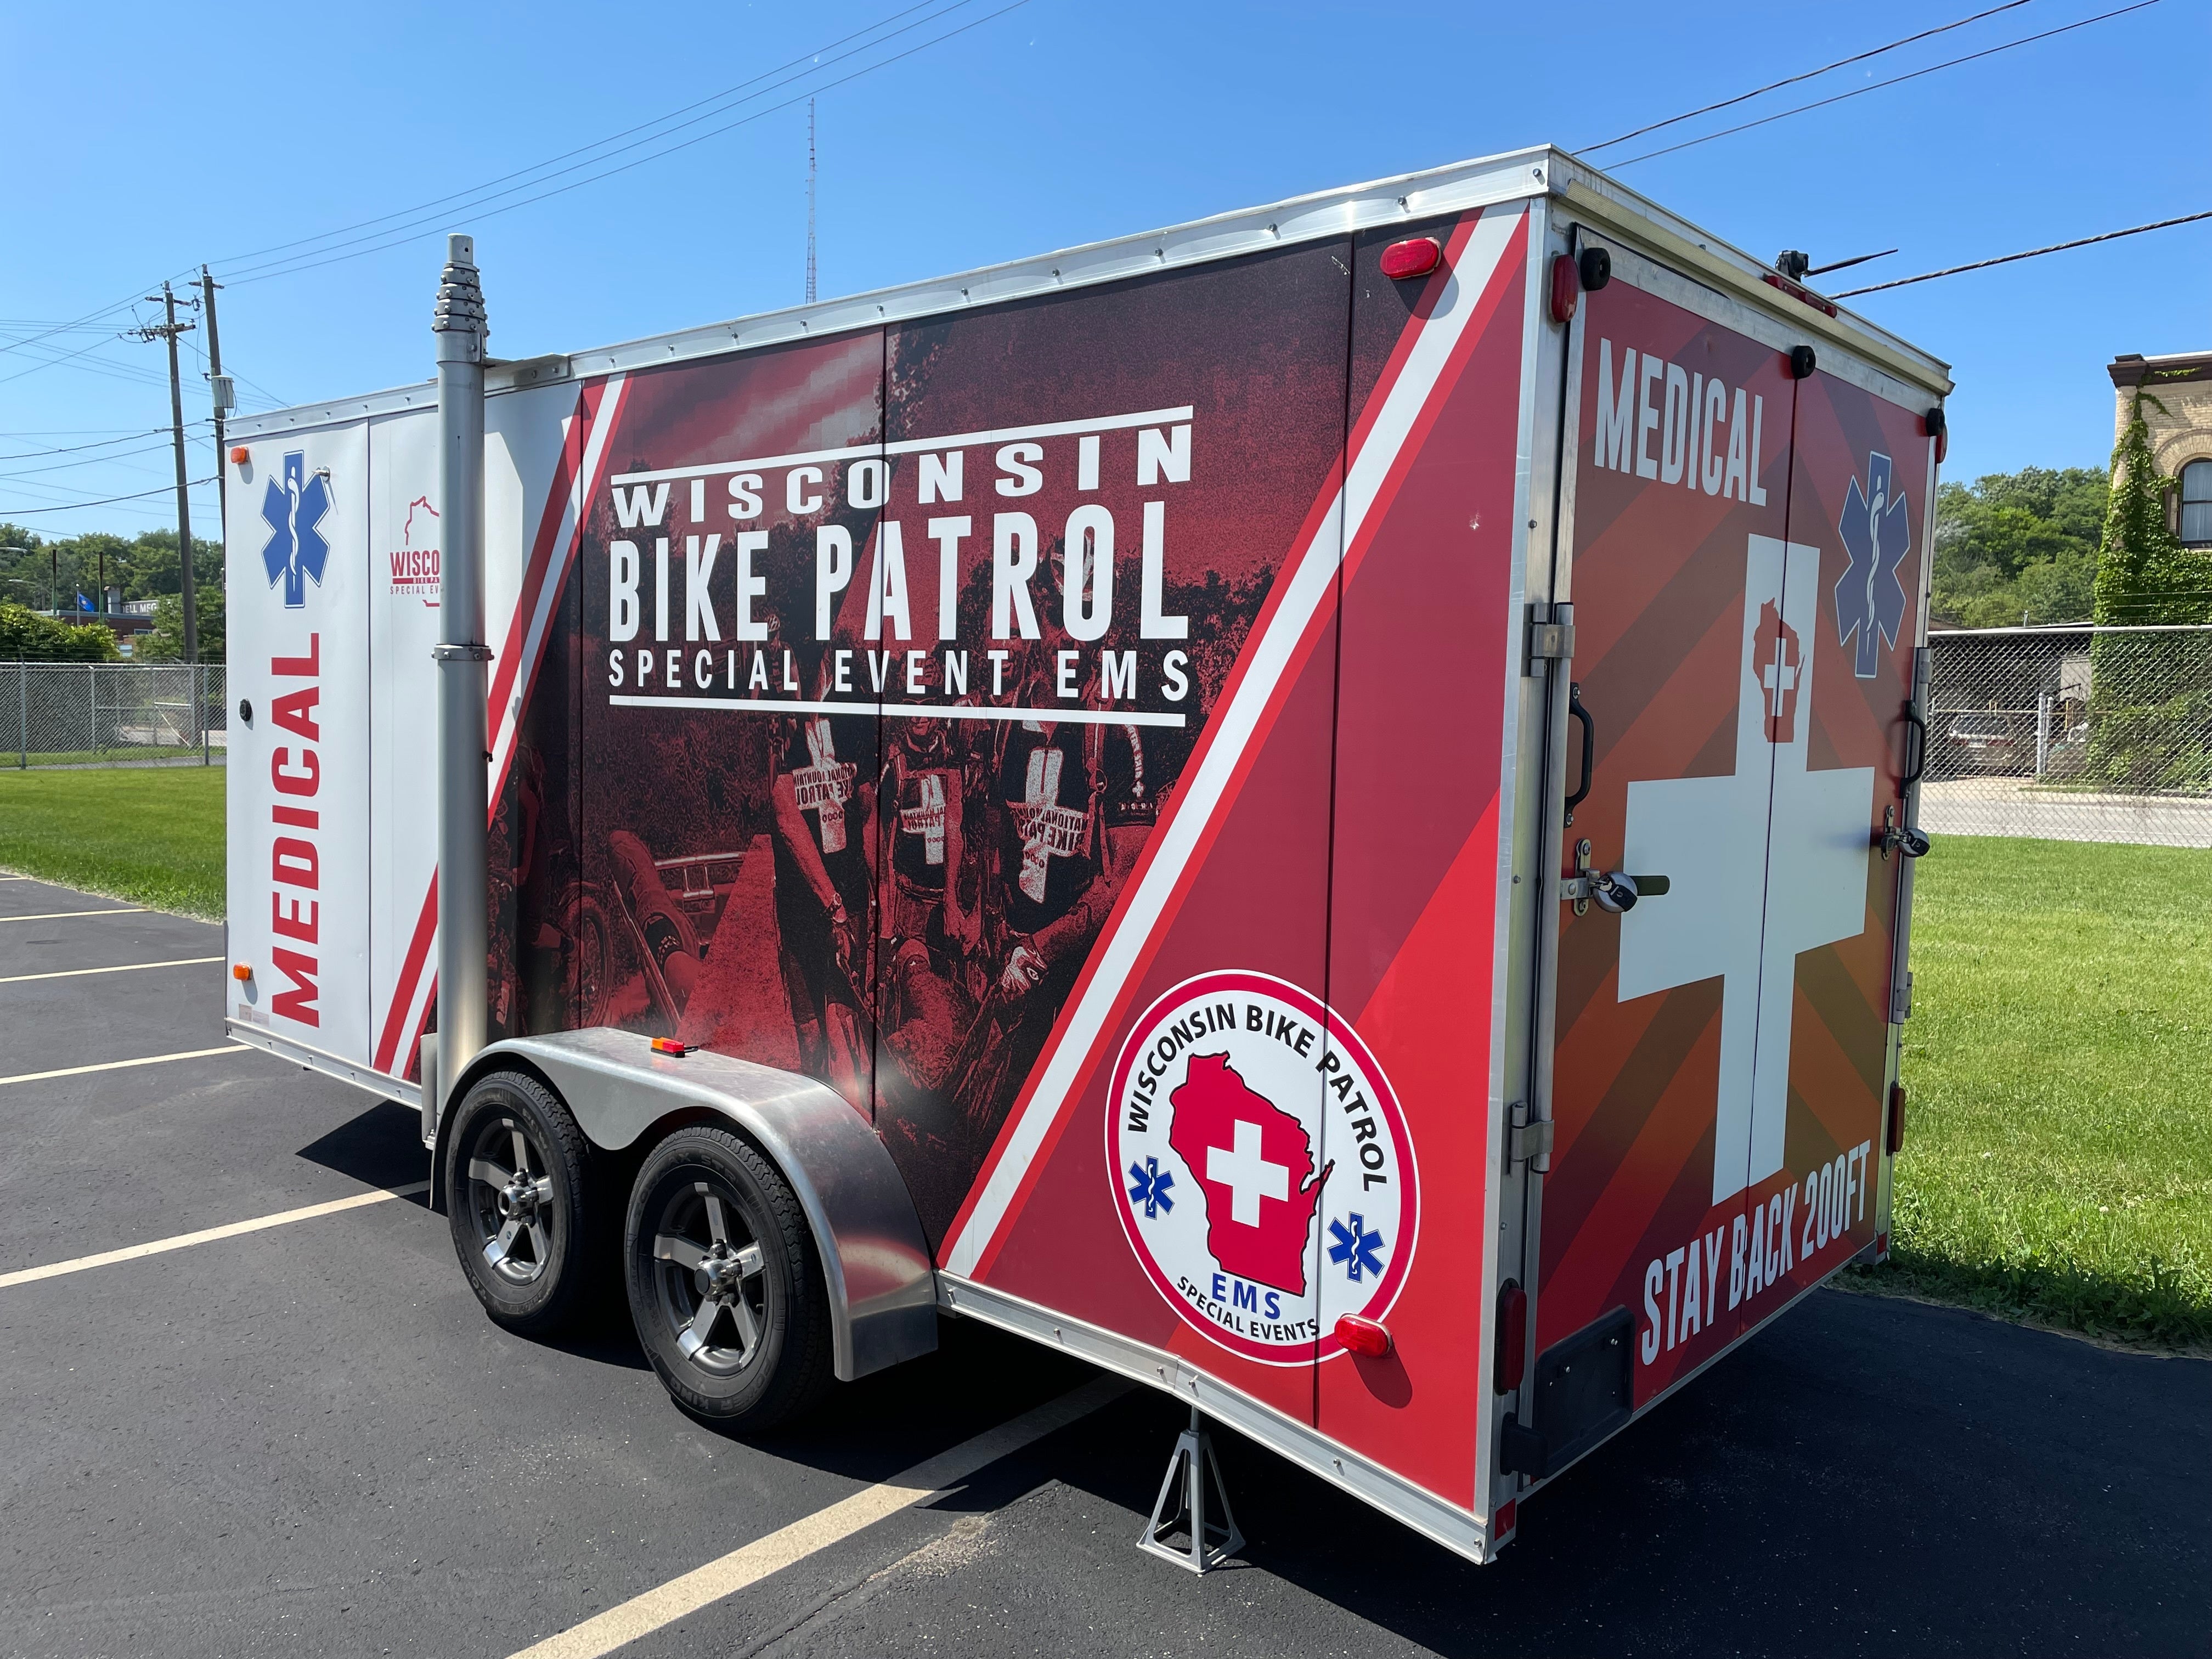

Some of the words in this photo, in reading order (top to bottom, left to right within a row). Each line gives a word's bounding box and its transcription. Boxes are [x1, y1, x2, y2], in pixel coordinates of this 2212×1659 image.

[1594, 337, 1767, 506] MEDICAL
[612, 424, 1191, 528] WISCONSIN
[390, 550, 439, 576] WISCO
[390, 586, 425, 594] SPECIAL
[610, 531, 769, 641] BIKE
[816, 501, 1188, 641] PATROL
[139, 603, 157, 613] MFG
[608, 649, 798, 691] SPECIAL
[836, 650, 1008, 696] EVENT
[1057, 650, 1189, 702] EMS
[271, 633, 319, 1028] MEDICAL
[1127, 1003, 1237, 1133] WISCONSIN
[1246, 1004, 1316, 1059] BIKE
[1316, 1048, 1387, 1192] PATROL
[1641, 1225, 1725, 1365] STAY
[1728, 1182, 1798, 1312] BACK
[1801, 1139, 1870, 1261] 200FT
[1177, 1276, 1244, 1334] SPECIAL
[1251, 1318, 1321, 1342] EVENTS
[1211, 1273, 1281, 1319] EMS
